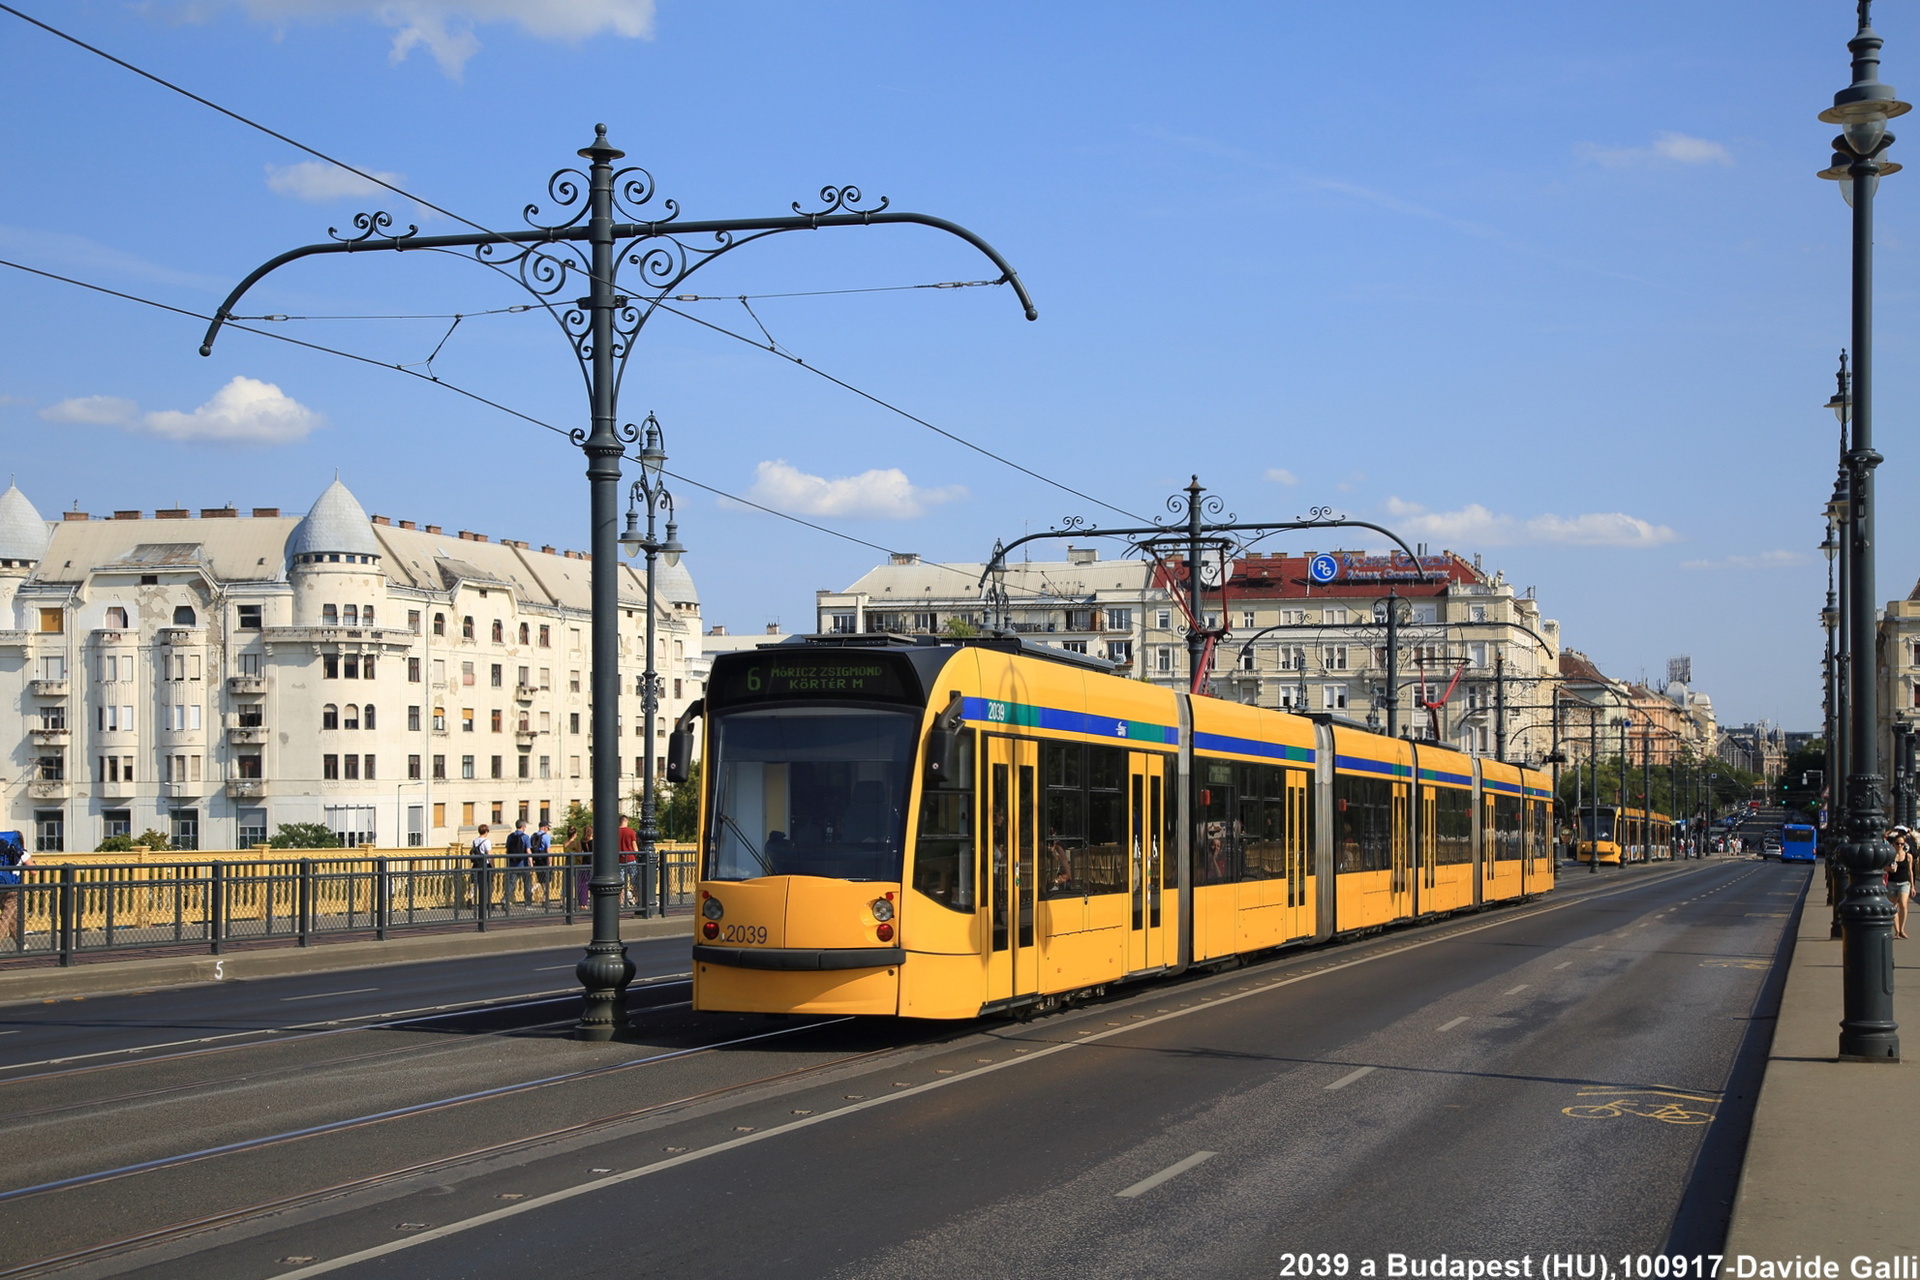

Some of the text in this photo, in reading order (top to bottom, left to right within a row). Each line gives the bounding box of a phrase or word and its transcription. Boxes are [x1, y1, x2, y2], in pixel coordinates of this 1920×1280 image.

[1317, 560, 1332, 576] RG
[747, 667, 761, 691] 6
[820, 666, 882, 677] ZSIGMOND
[789, 678, 864, 690] KÖRTÉR M
[988, 702, 1005, 721] 2039
[726, 924, 767, 944] 2039
[214, 960, 224, 980] 5
